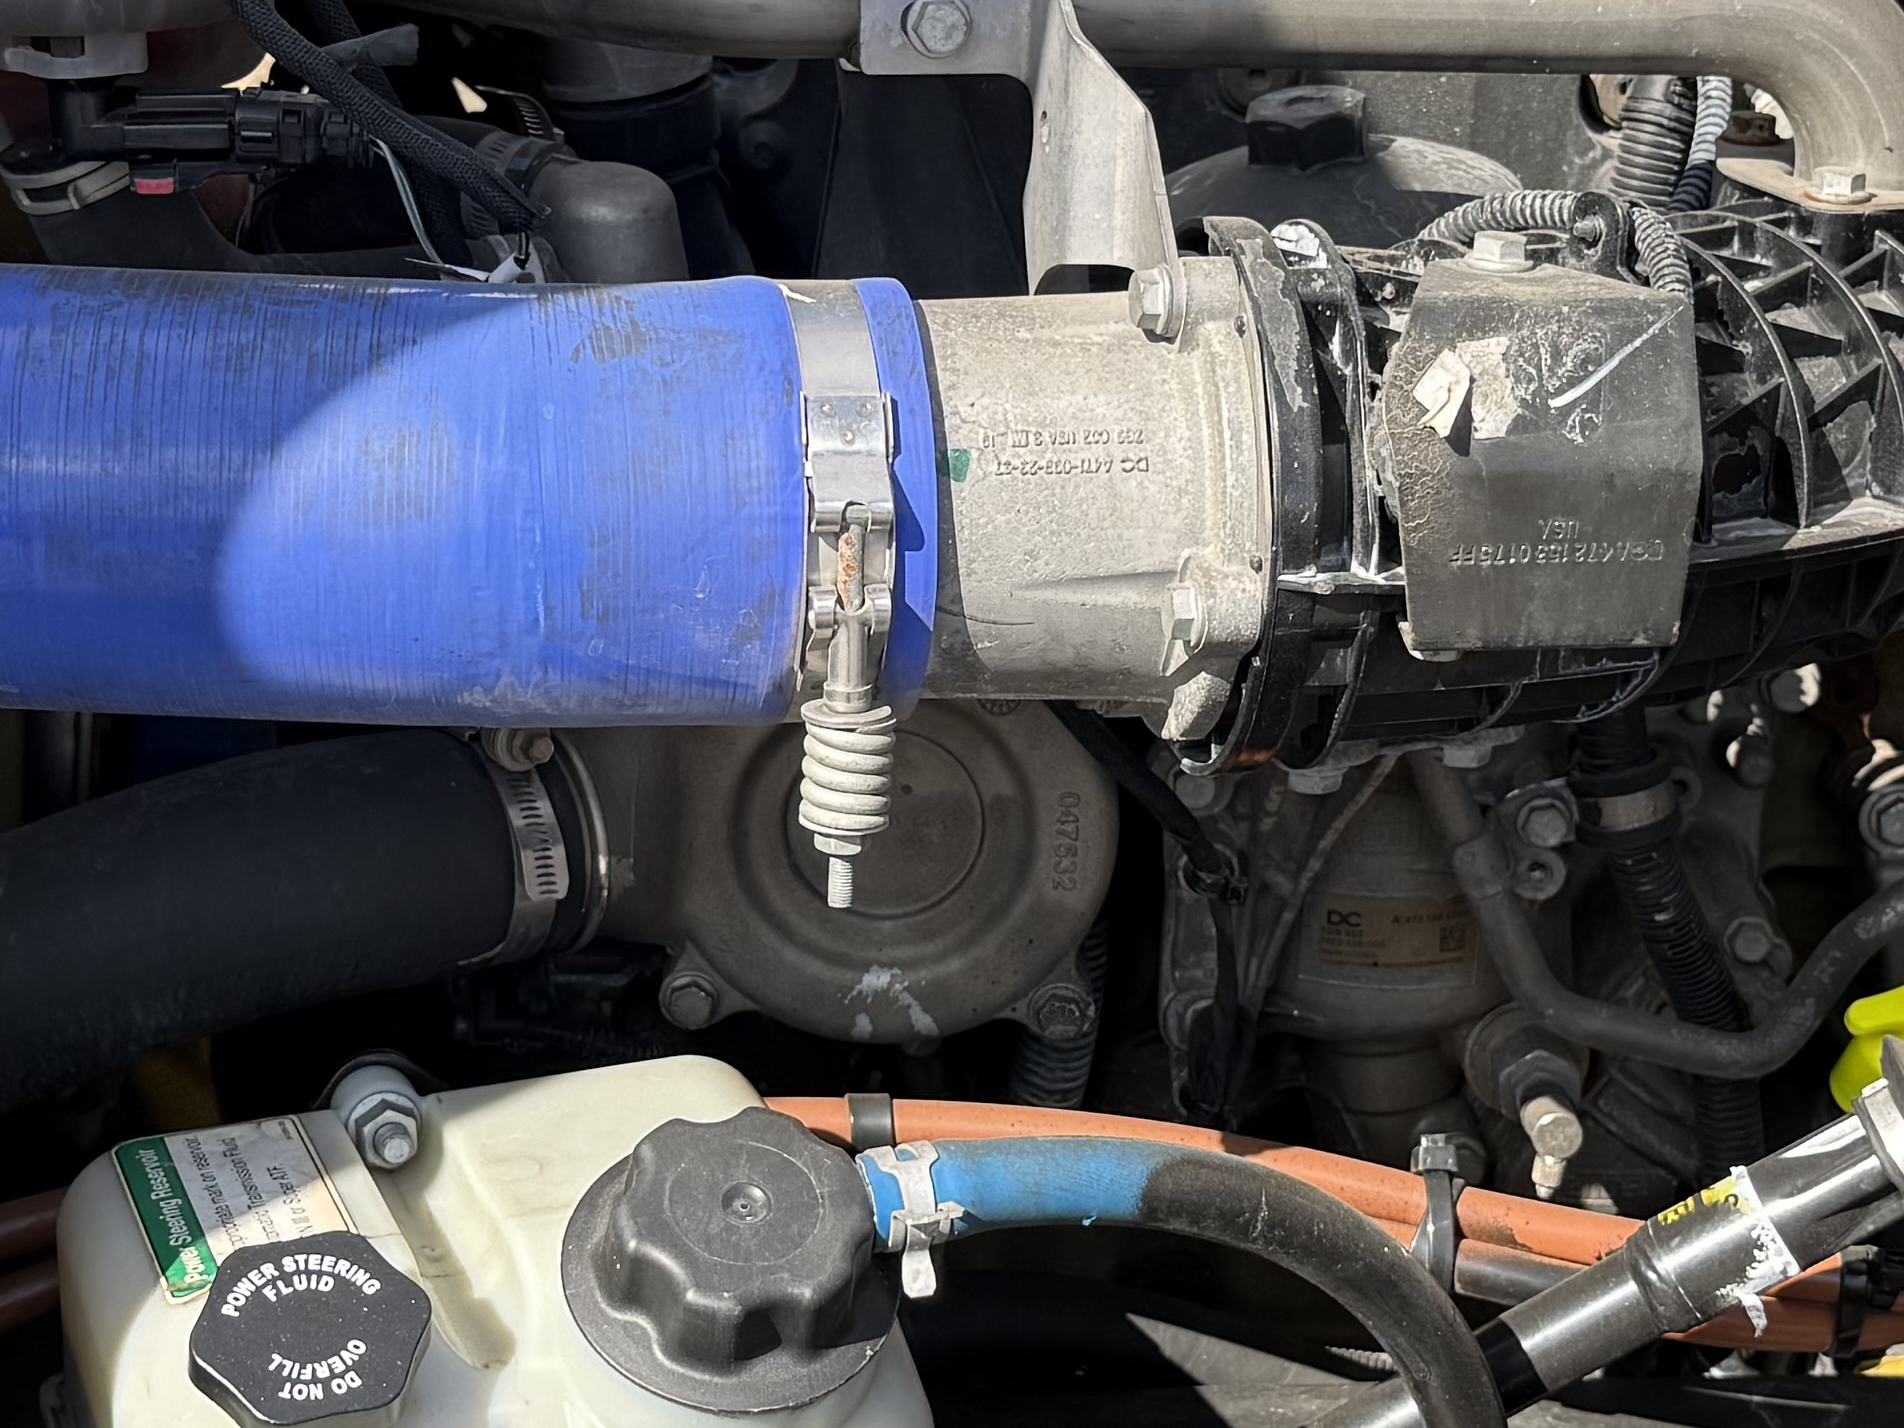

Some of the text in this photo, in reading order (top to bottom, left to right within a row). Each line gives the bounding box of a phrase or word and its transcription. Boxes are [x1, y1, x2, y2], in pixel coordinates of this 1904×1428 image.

[1327, 909, 1362, 927] DC
[198, 1169, 217, 1183] on
[219, 1137, 265, 1210] Transmission Fluid
[203, 1180, 226, 1205] mark
[136, 1149, 208, 1284] Power Steering Reservoir
[221, 1254, 382, 1318] POWER STEERING
[262, 1274, 335, 1302] FLUID
[268, 1339, 367, 1380] OVERFILL
[278, 1371, 363, 1401] DO NOT
